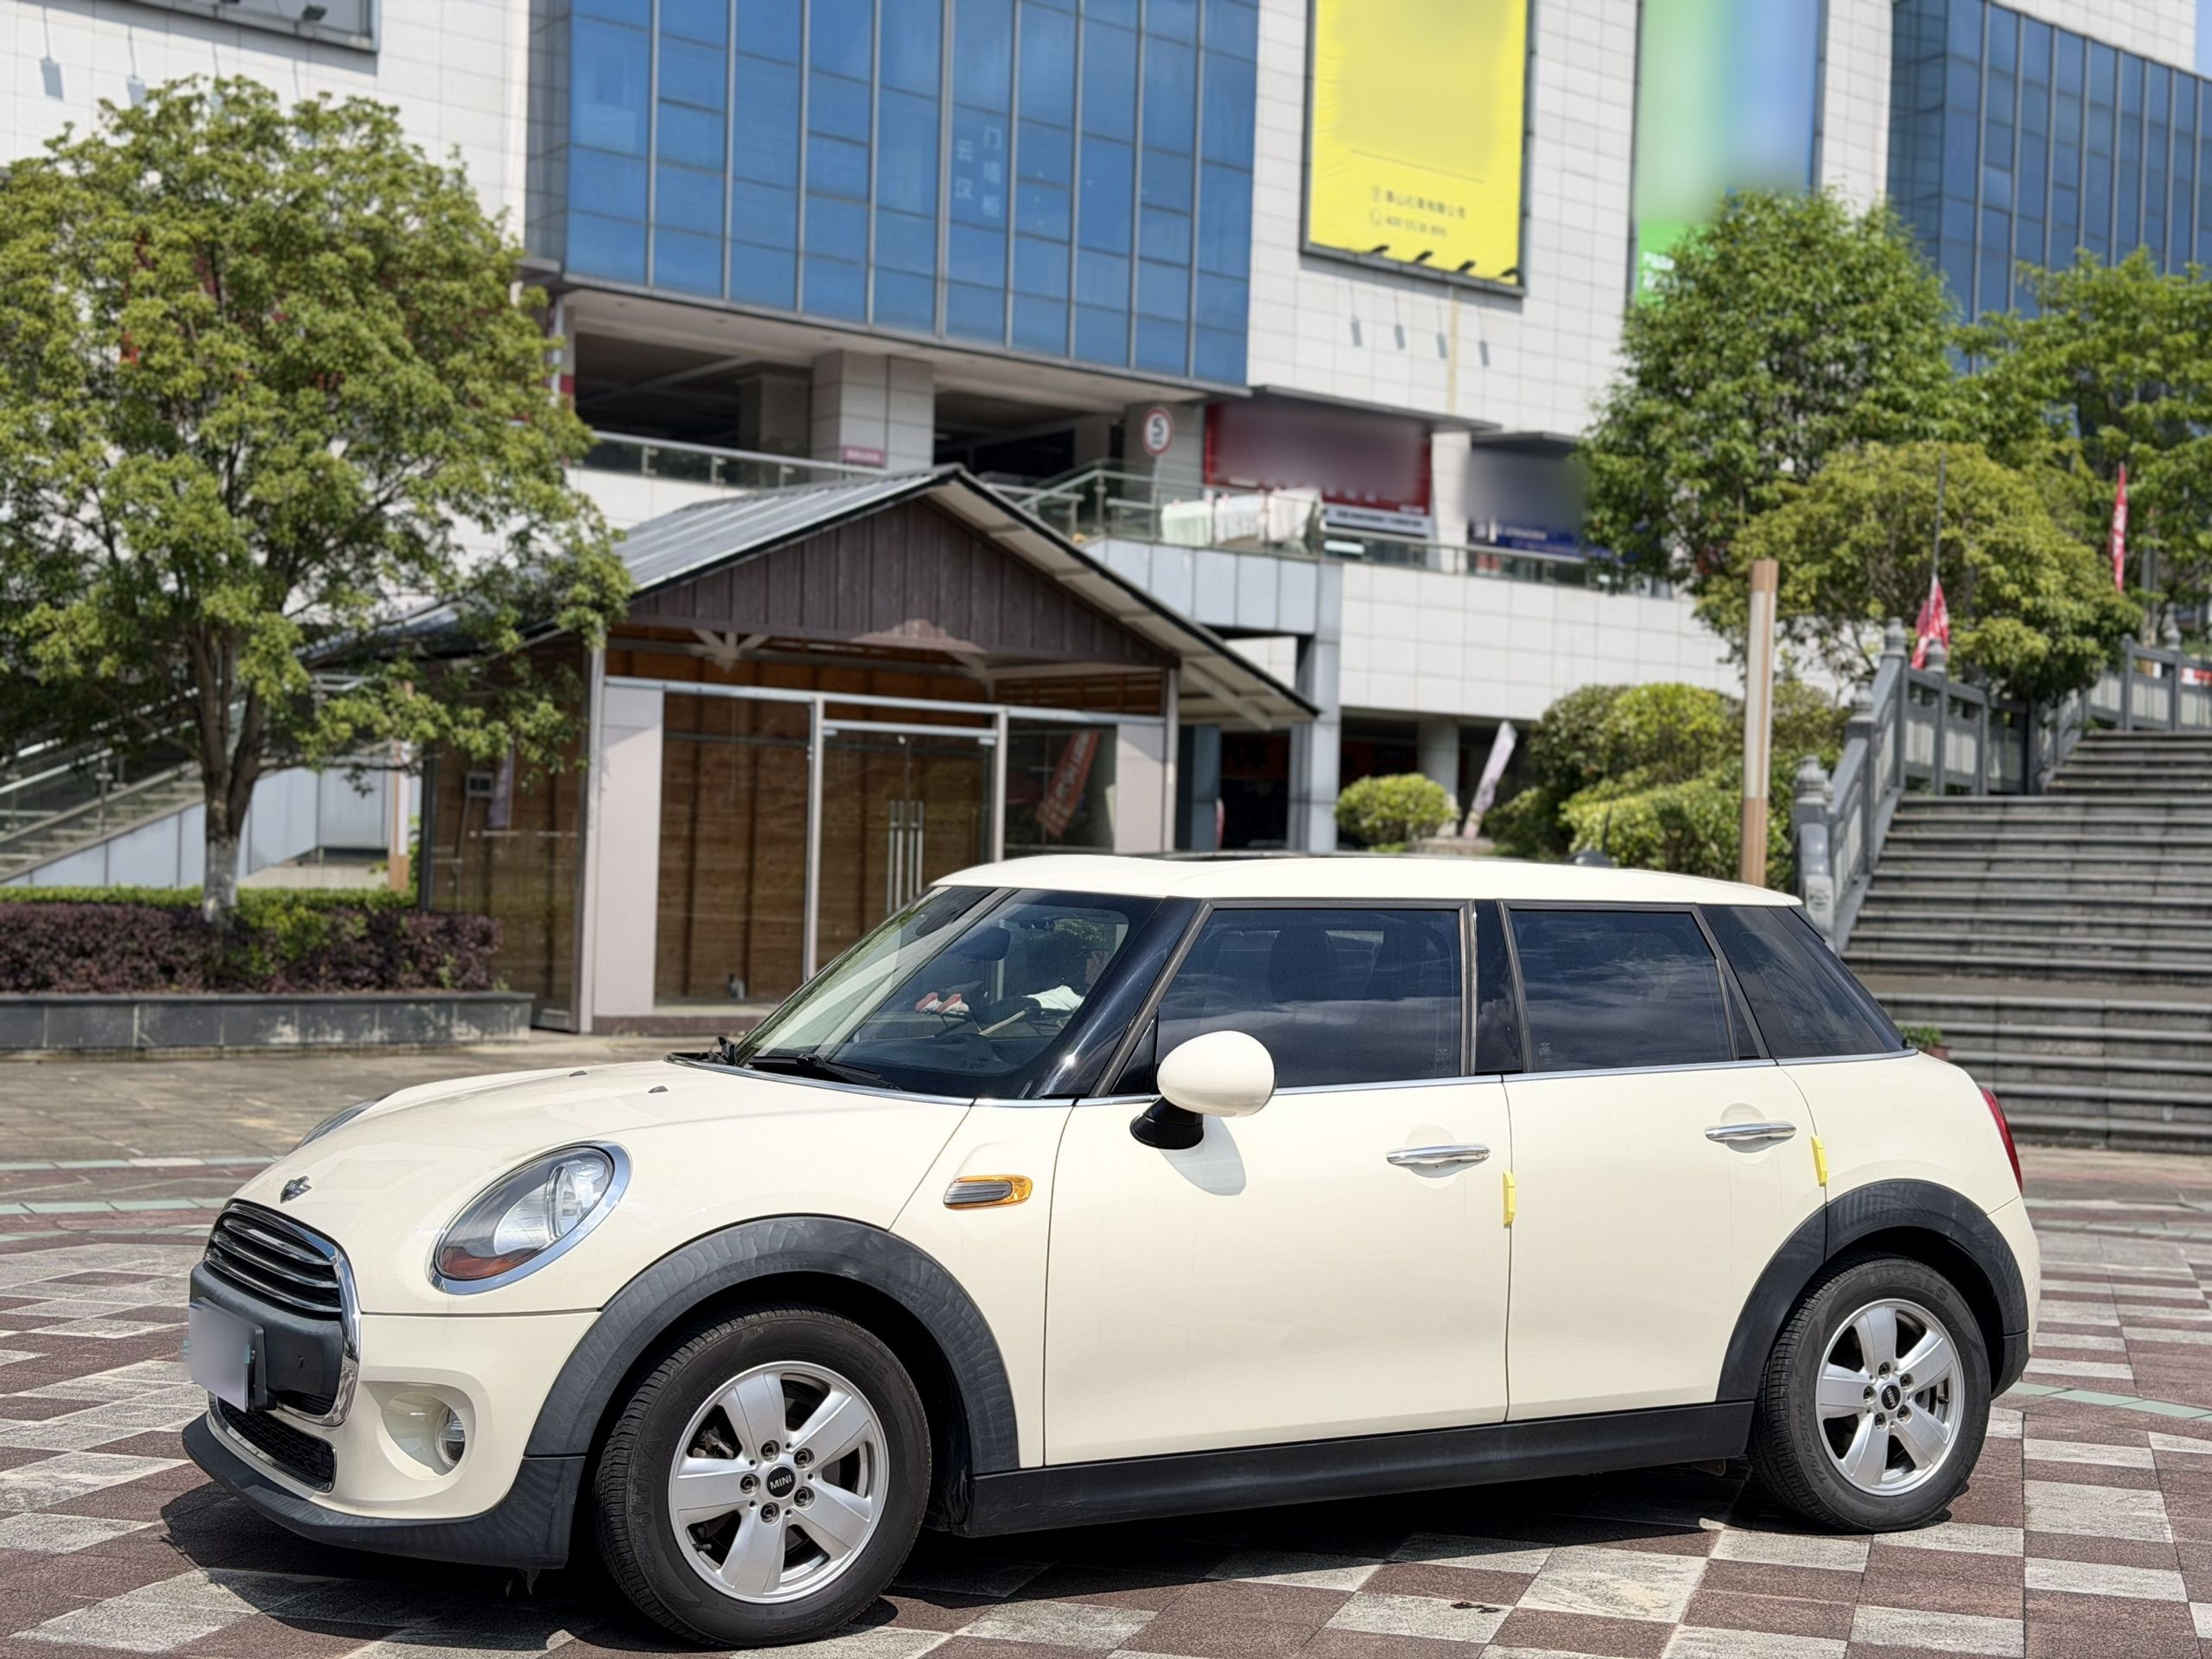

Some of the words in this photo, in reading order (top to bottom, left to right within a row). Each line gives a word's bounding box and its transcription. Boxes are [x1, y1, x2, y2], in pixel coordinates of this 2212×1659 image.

[1153, 418, 1164, 437] 5
[1886, 1388, 1896, 1407] MINI
[770, 1474, 792, 1490] MINI
